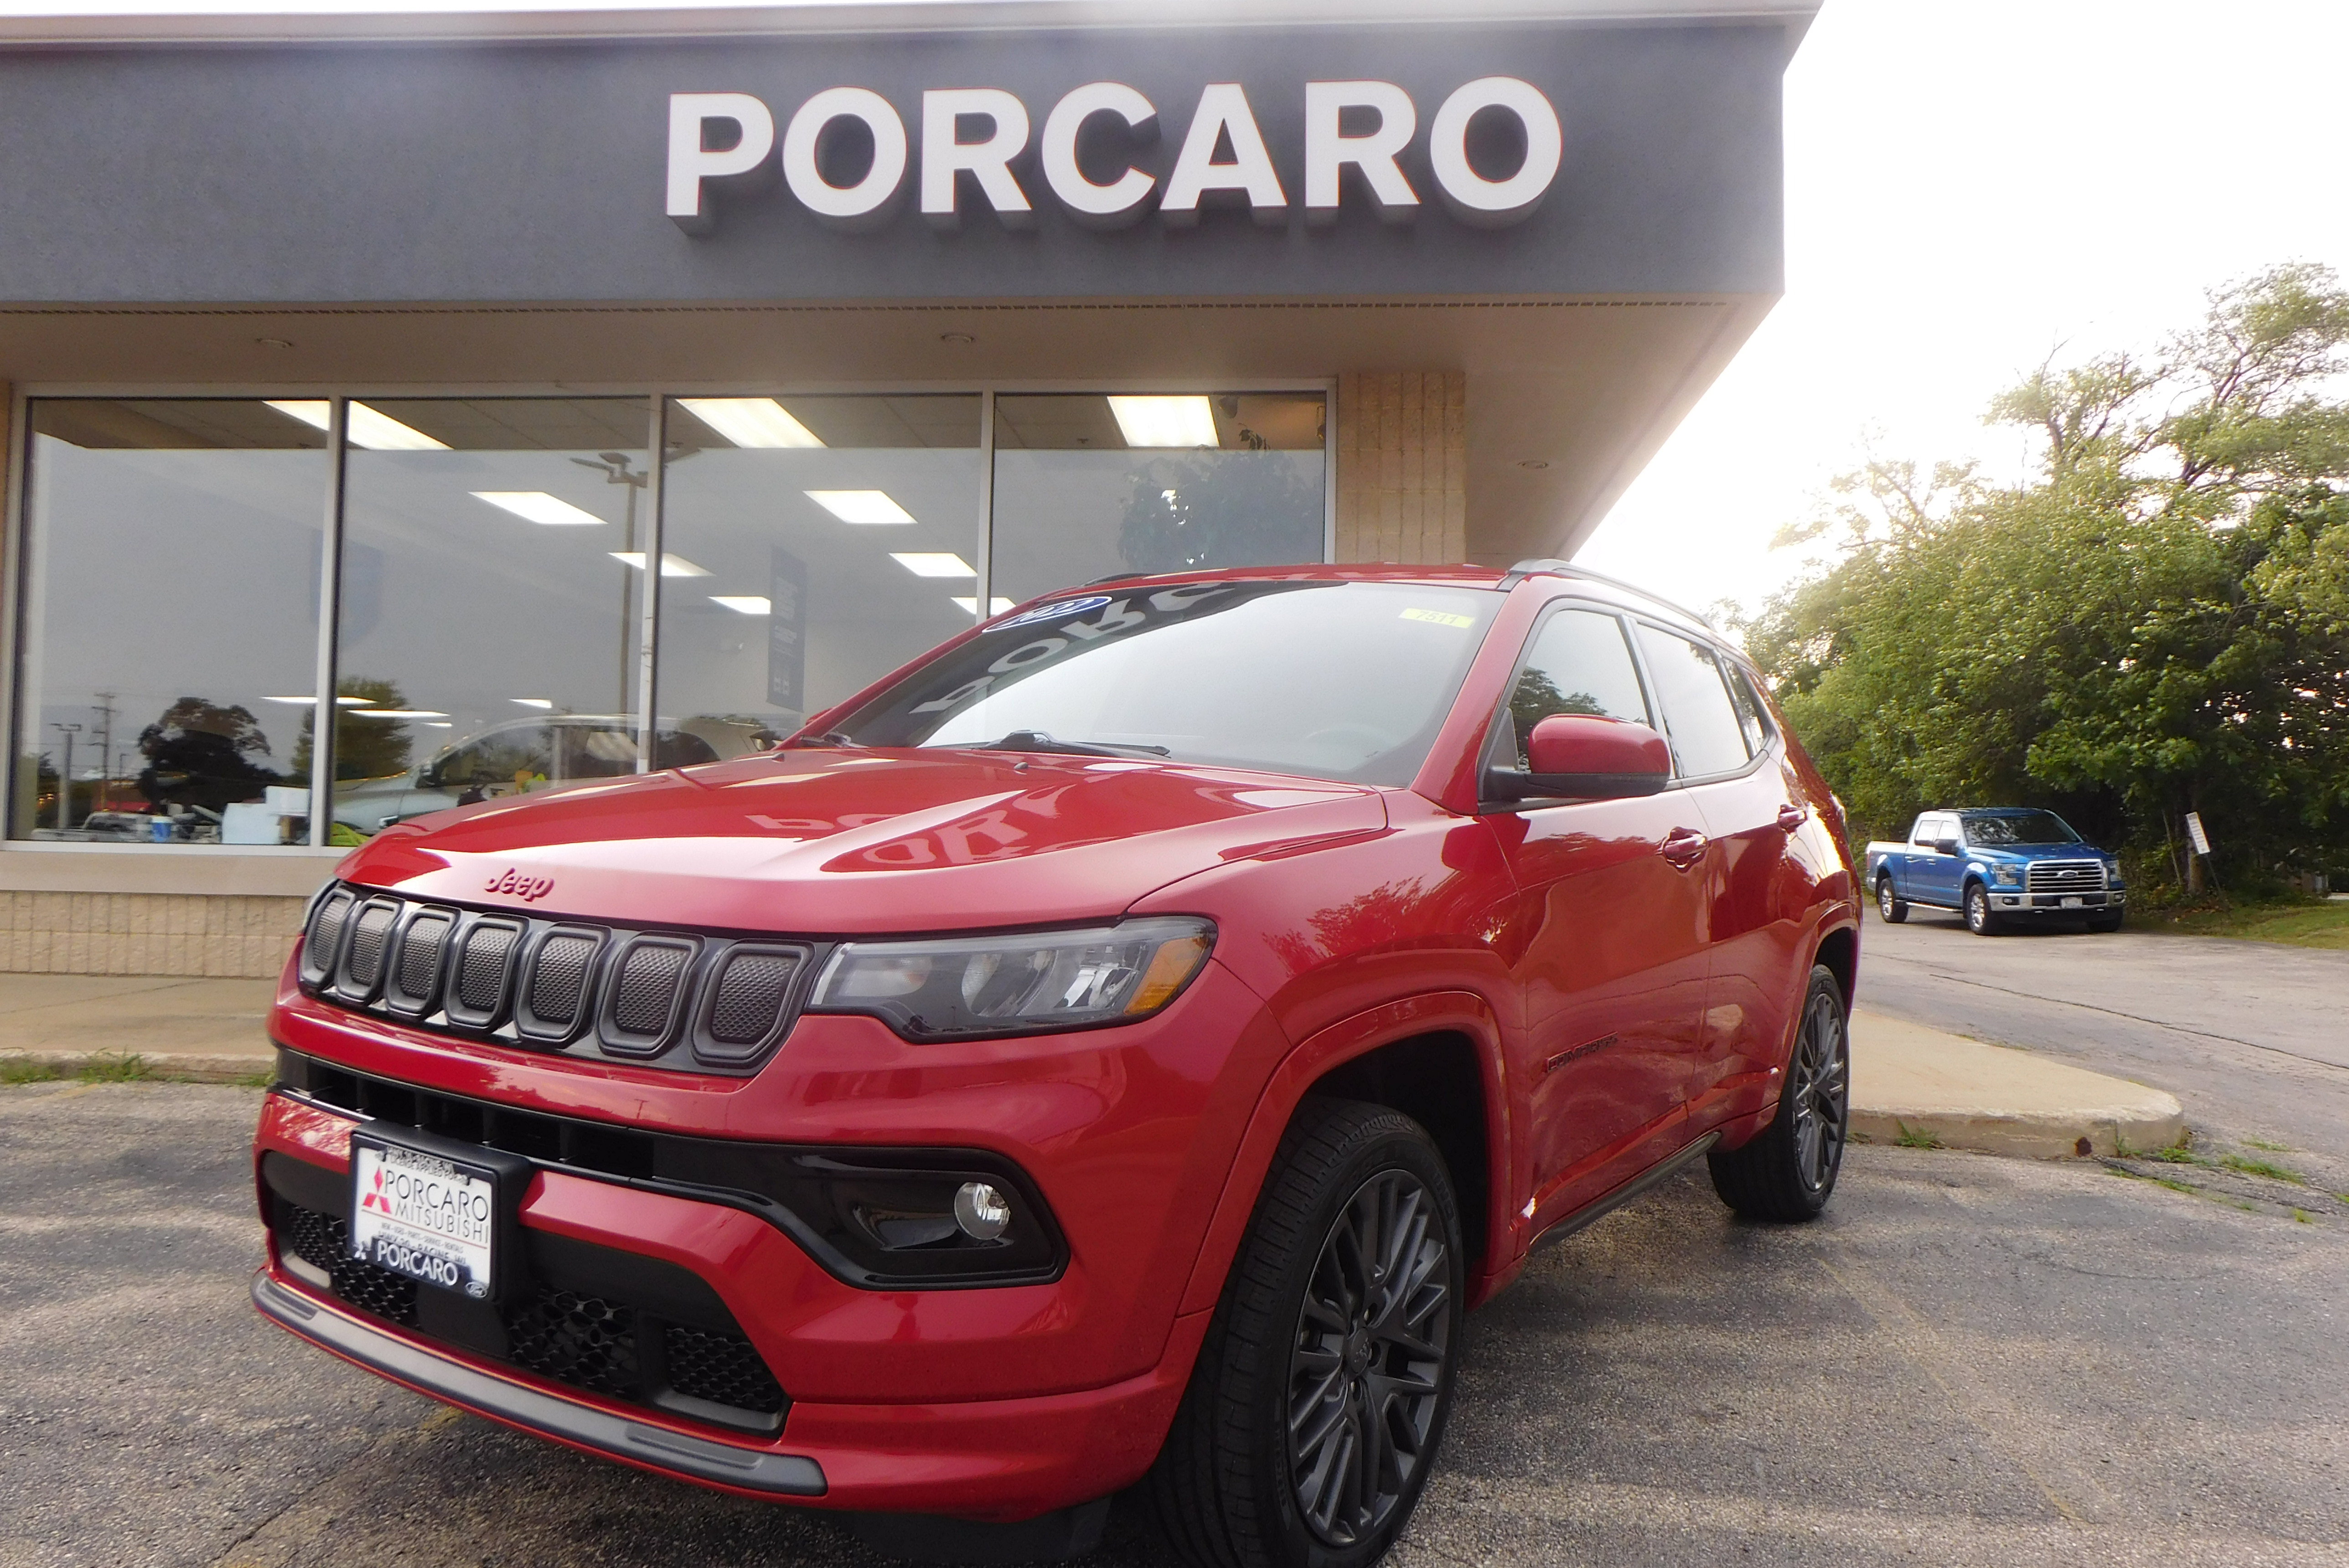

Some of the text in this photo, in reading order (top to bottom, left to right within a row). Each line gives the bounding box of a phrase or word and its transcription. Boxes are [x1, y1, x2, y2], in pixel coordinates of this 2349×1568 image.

[666, 76, 1563, 217] PORCARO
[1416, 611, 1458, 624] 7511
[484, 867, 554, 902] Jeep
[384, 1170, 488, 1222] PORCARO
[395, 1200, 489, 1243] MITSUBISHI
[377, 1240, 458, 1286] PORCARO
